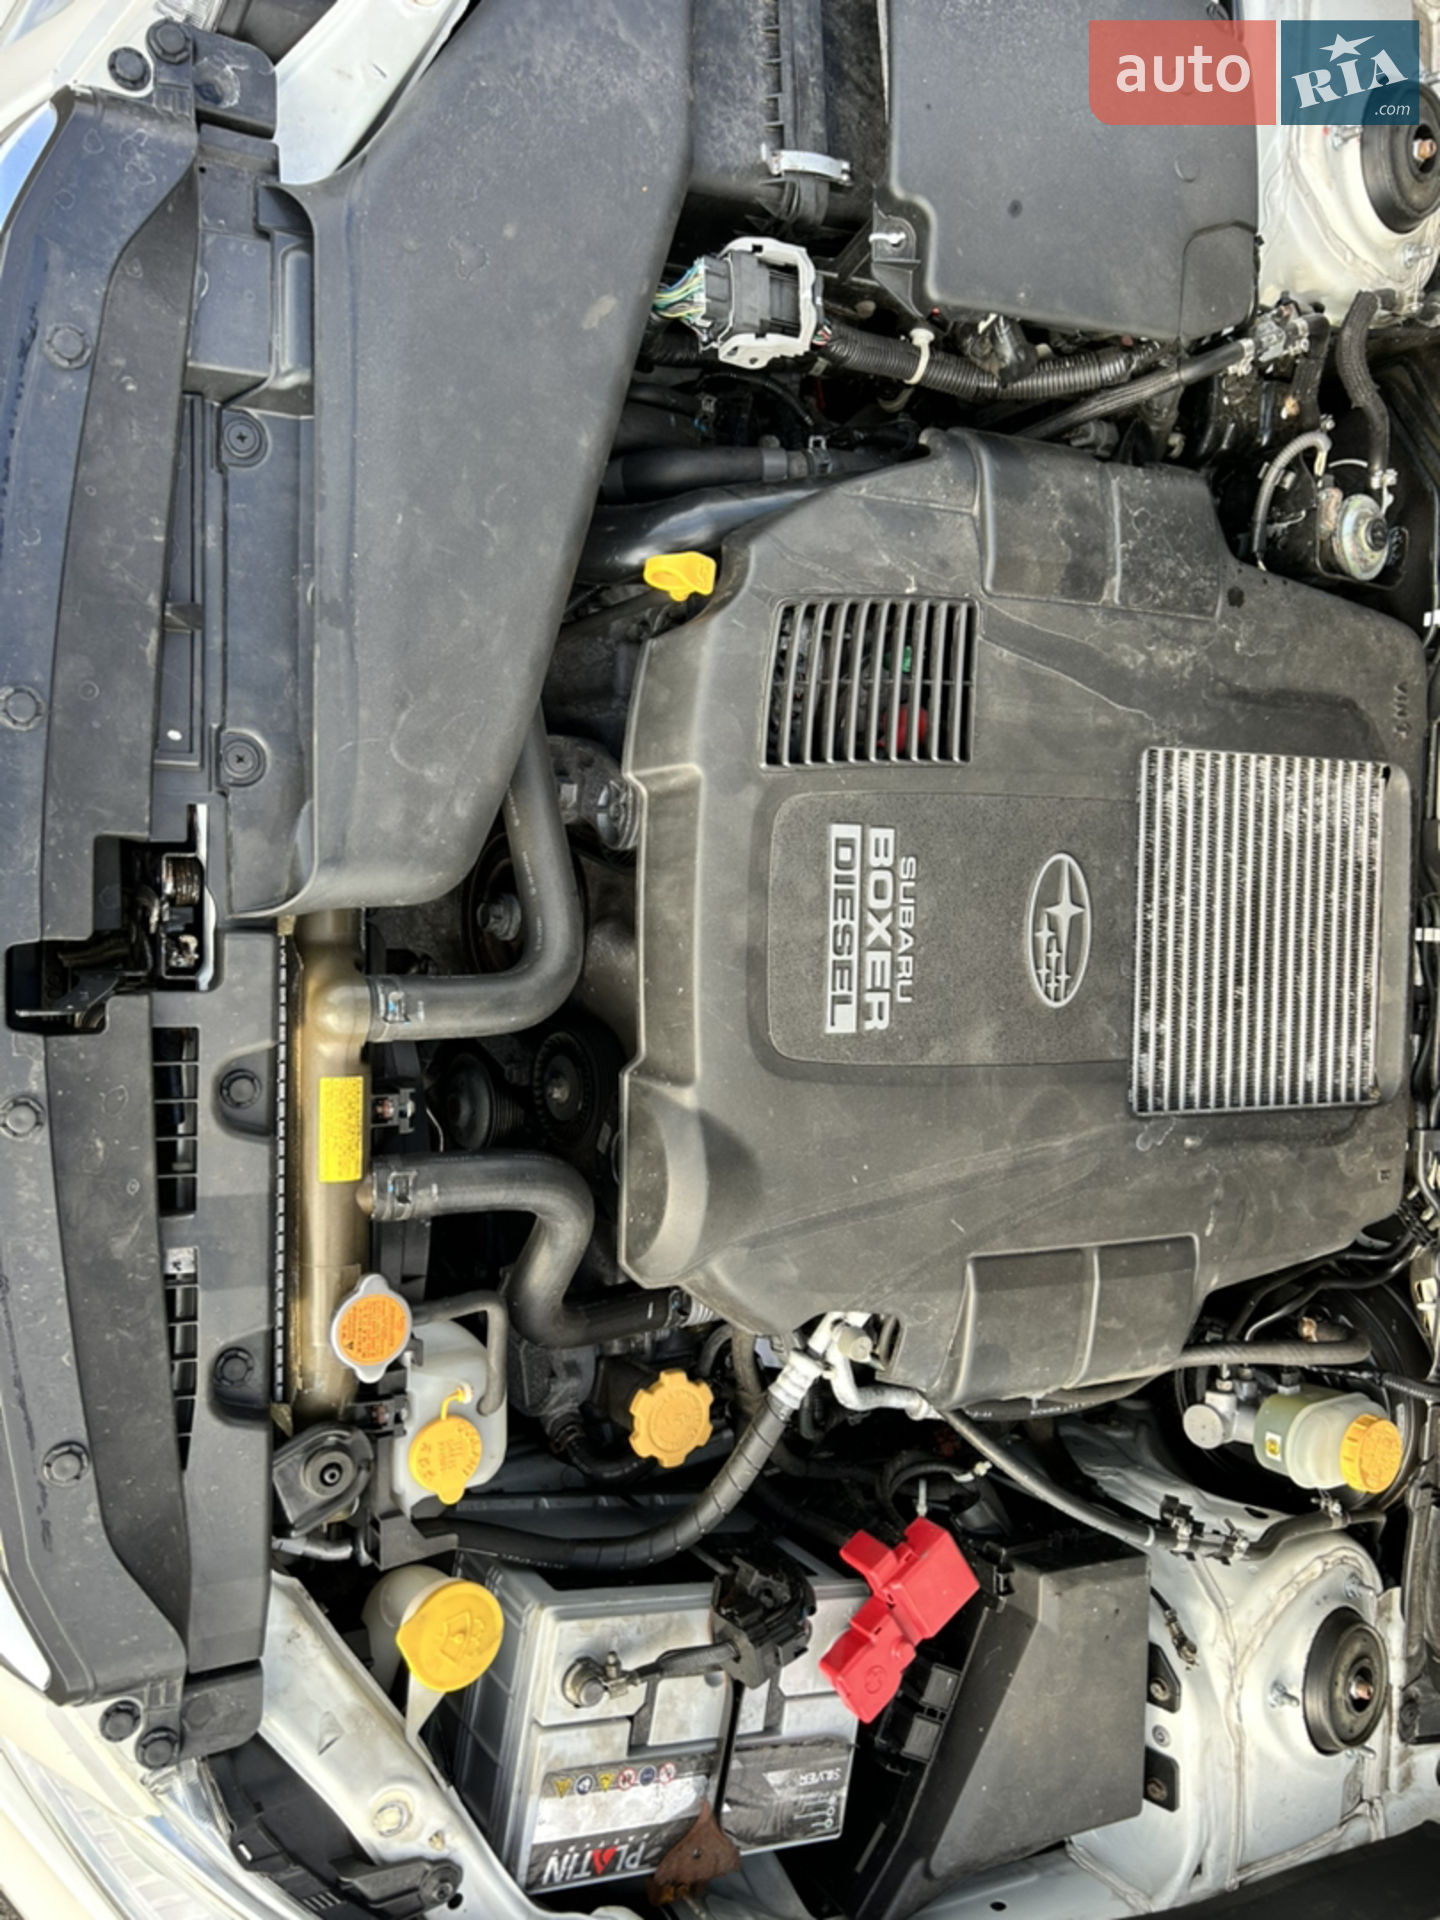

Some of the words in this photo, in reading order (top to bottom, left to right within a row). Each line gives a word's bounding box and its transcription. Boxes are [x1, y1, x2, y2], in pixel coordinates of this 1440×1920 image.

[830, 835, 857, 1027] DIESEL
[864, 827, 896, 1031] BOXER
[896, 857, 917, 1003] SUBARU
[799, 1767, 842, 1787] SILVER
[541, 1841, 646, 1885] PLATIN
